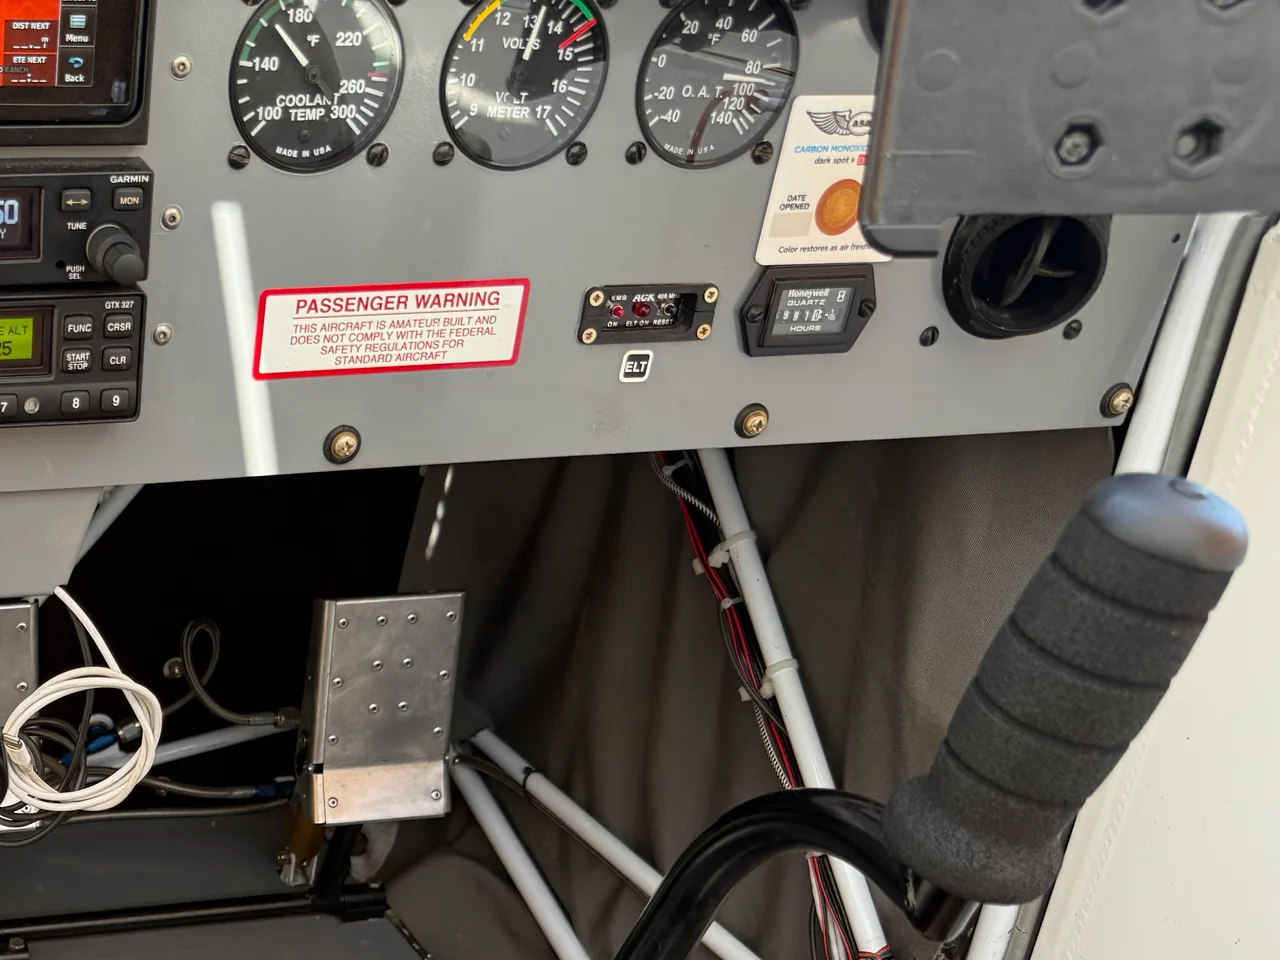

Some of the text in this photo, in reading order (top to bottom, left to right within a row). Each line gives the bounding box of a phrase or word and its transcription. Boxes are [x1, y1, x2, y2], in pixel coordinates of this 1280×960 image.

[287, 9, 313, 23] 180
[12, 22, 50, 30] DIST NEXT
[547, 21, 563, 35] 14
[65, 34, 88, 43] Menu
[741, 29, 758, 43] 60
[13, 56, 46, 64] ETE NEXT
[557, 48, 573, 61] 15
[253, 57, 279, 71] 140
[65, 74, 84, 83] Back
[340, 79, 365, 94] 260
[551, 79, 567, 93] 16
[732, 83, 754, 96] 100
[289, 108, 325, 121] TEMP
[330, 104, 356, 119] 300
[487, 105, 530, 118] METER
[276, 145, 332, 158] MADE USA
[794, 145, 829, 153] CARBON
[814, 157, 831, 165] dark
[833, 157, 849, 165] spot
[110, 175, 149, 184] GARMIN
[120, 197, 139, 205] MON
[787, 194, 806, 202] DATE
[779, 203, 810, 211] OPENED
[67, 222, 87, 230] TUNE
[778, 243, 849, 254] Color restores air
[66, 265, 85, 273] PUSH
[788, 288, 830, 298] Honeywell
[105, 301, 134, 309] GTX 327
[295, 291, 500, 315] PASSENGER WARNING
[68, 323, 92, 333] FUNC
[107, 322, 131, 332] CRSR
[293, 315, 497, 334] THIS AIRCRAFT IS AMATEUR BUILT AND
[8, 325, 29, 336] ALT
[290, 326, 496, 345] DOES NOT COMPLY WITH THE FEDERAL
[320, 339, 464, 355] SAFETY REGULATIONS FOR
[66, 353, 89, 362] START
[109, 356, 126, 365] CLR
[334, 351, 448, 365] STANDARD AIRCRAFT
[67, 362, 88, 371] STOP
[625, 361, 647, 372] ELT
